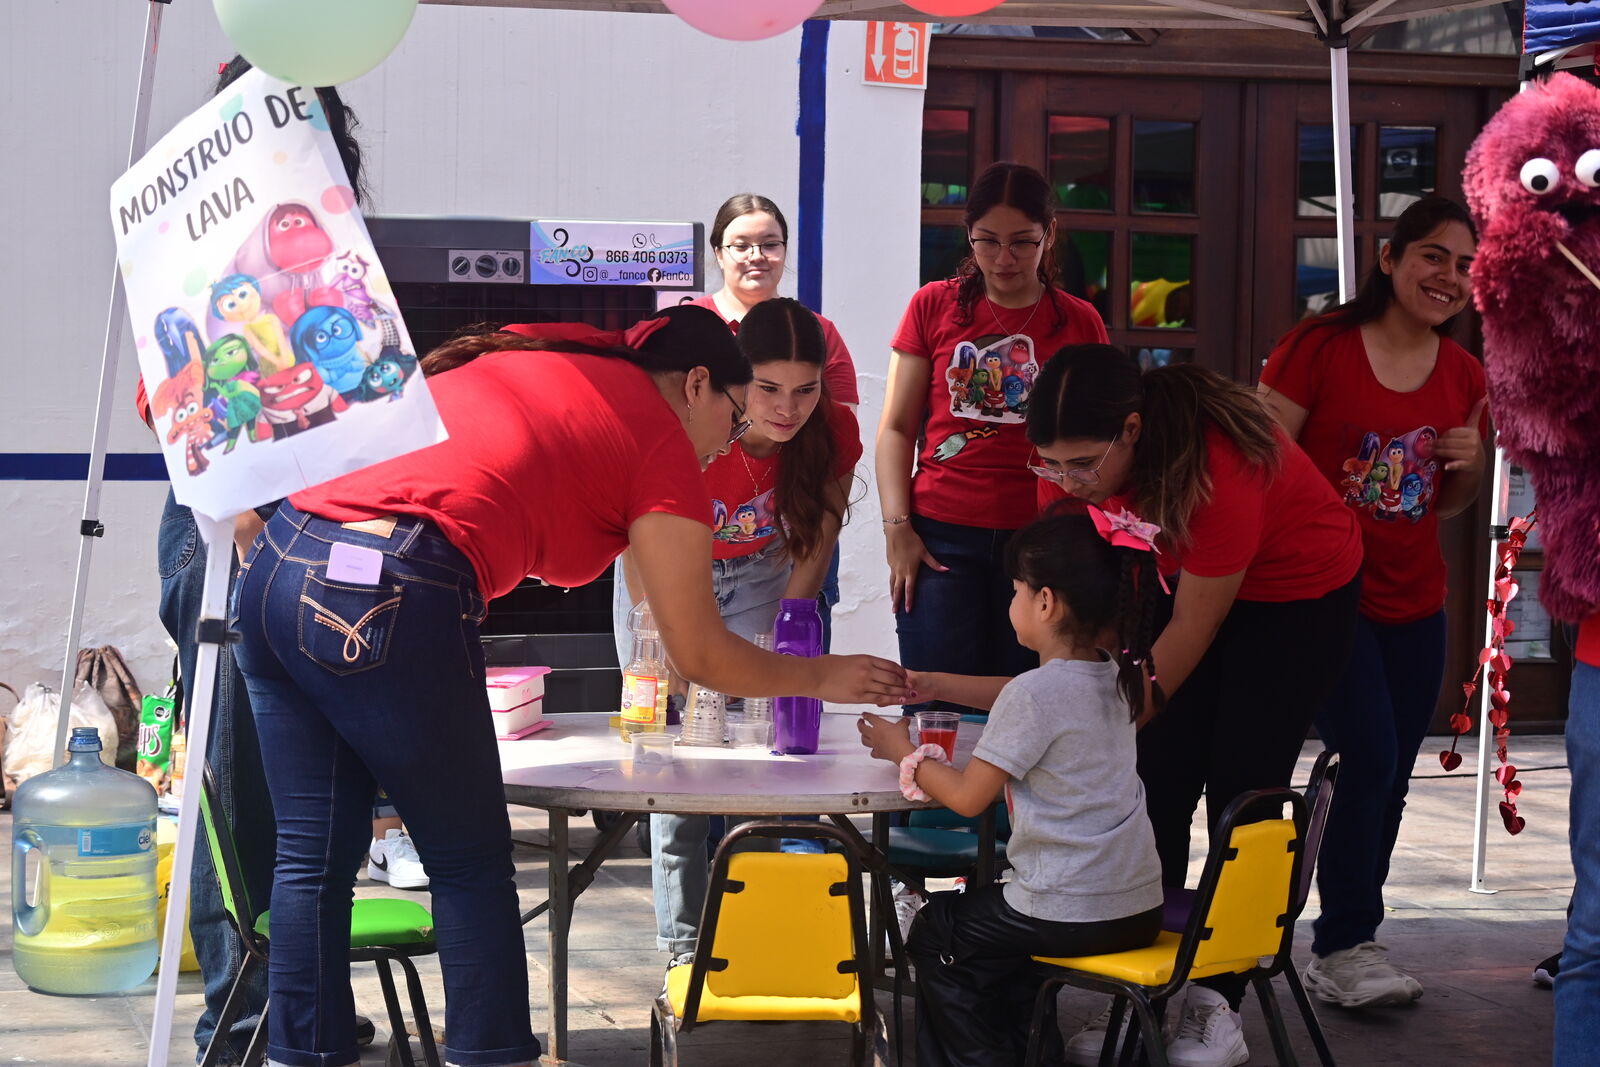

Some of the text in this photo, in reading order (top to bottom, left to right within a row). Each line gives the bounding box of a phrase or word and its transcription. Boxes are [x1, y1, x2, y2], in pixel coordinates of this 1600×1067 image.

[119, 86, 314, 236] MONSTRUO DE
[186, 176, 255, 242] LAVA
[606, 250, 688, 265] 866 406 0373
